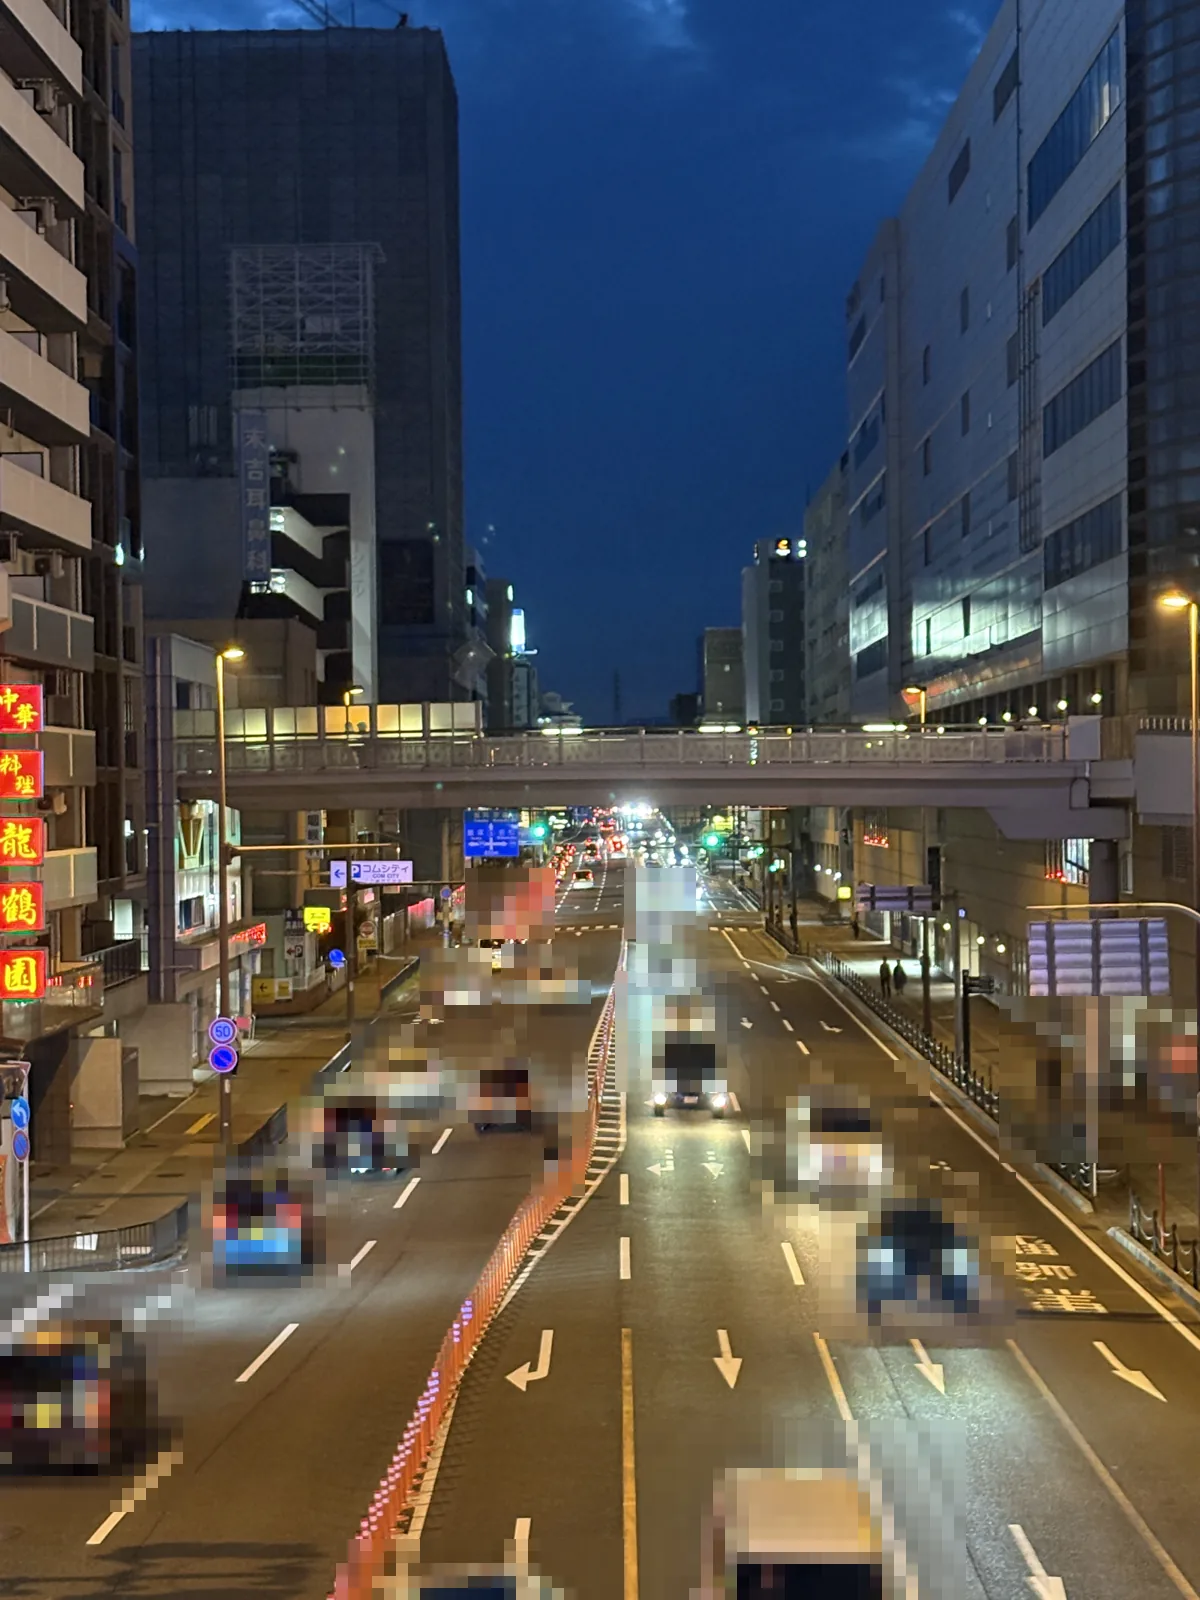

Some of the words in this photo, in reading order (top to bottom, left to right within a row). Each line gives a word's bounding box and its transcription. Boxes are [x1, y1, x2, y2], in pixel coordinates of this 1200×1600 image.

[363, 863, 409, 873] コムシティ
[215, 1025, 231, 1038] 50
